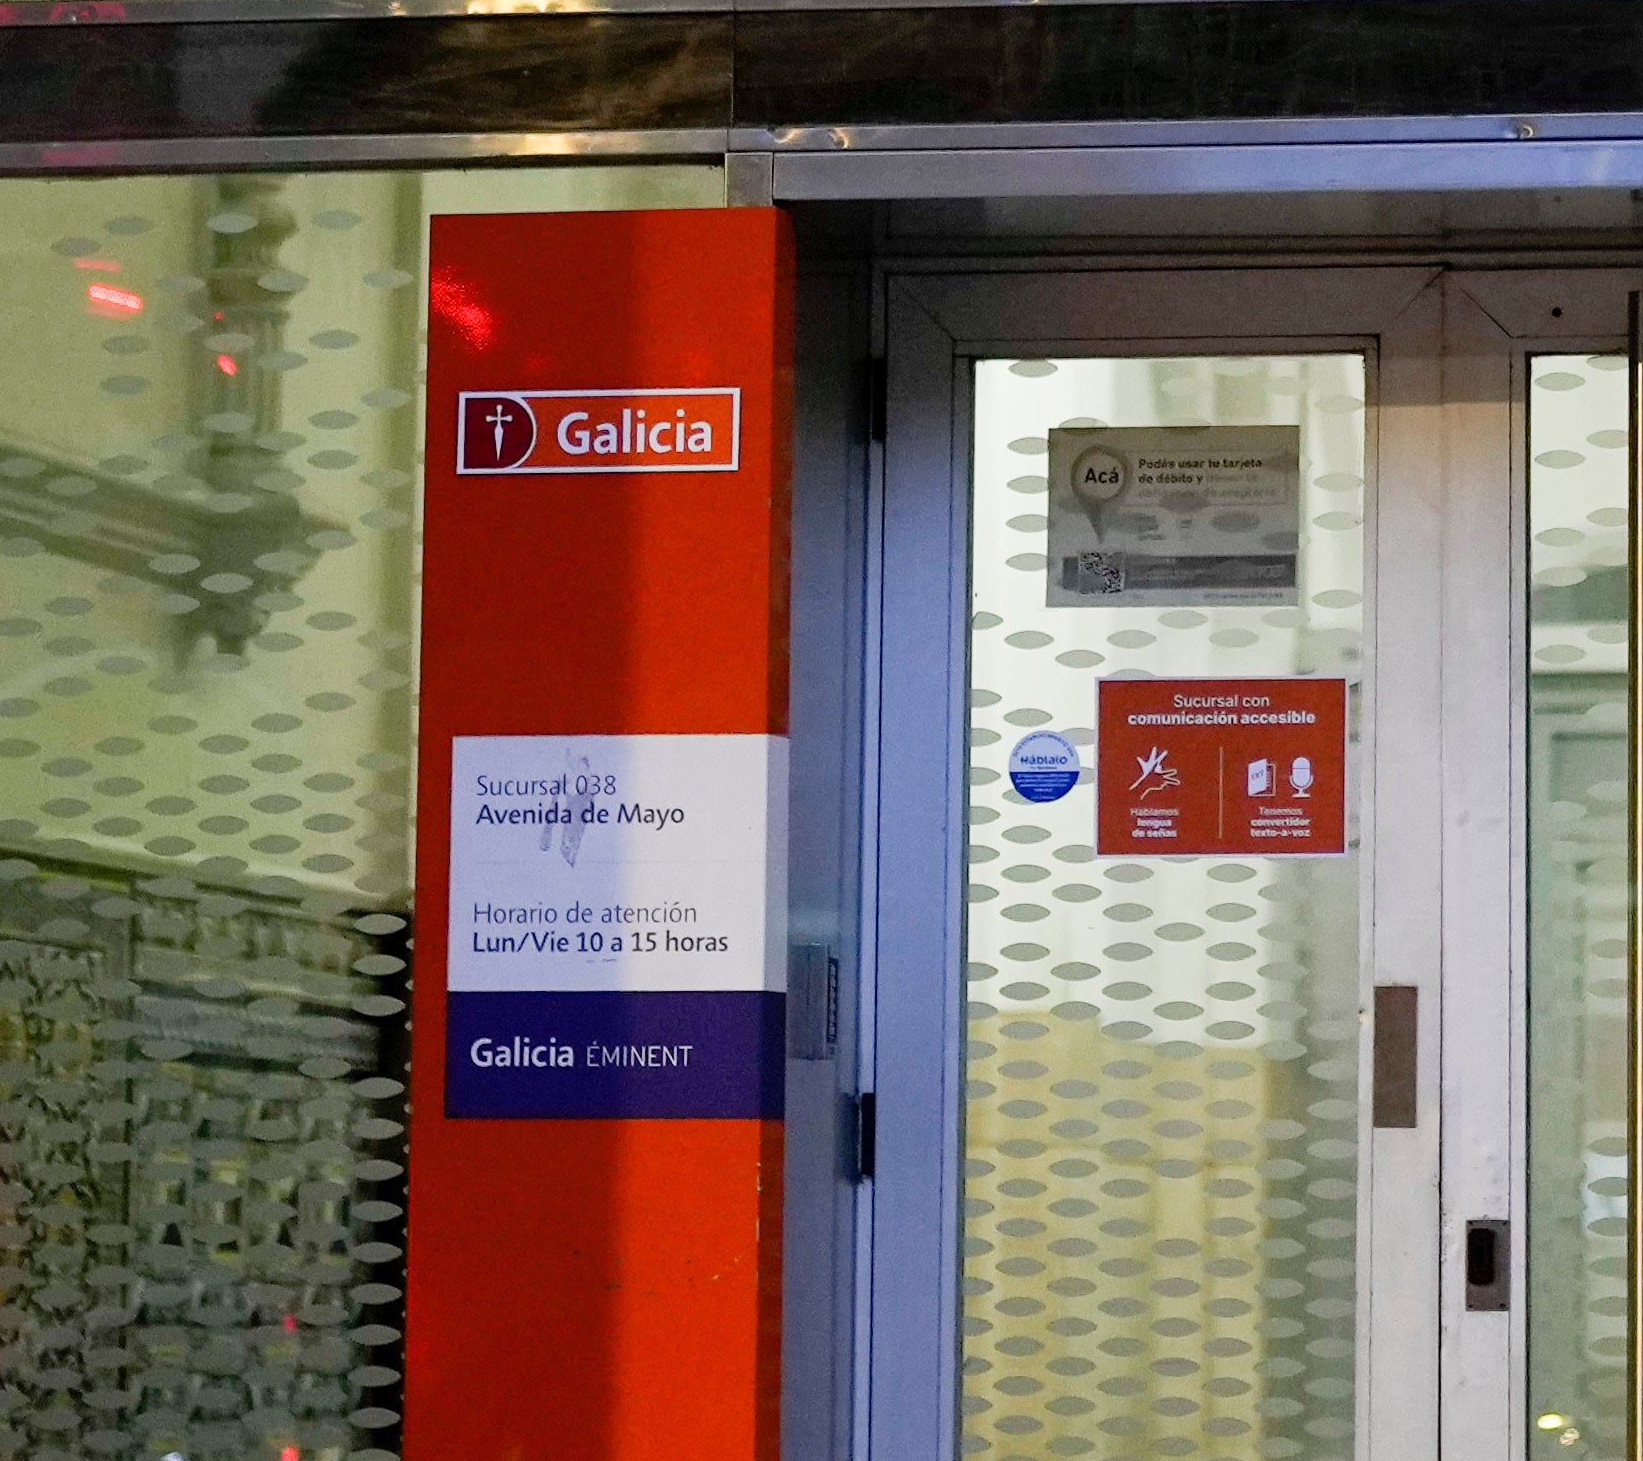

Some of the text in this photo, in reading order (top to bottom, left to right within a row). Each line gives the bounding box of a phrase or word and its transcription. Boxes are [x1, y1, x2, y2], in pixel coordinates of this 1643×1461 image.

[557, 408, 713, 455] Galicia
[1138, 458, 1263, 471] Podés usar tu tarjeta
[1084, 467, 1119, 484] Acá
[1138, 474, 1154, 484] de
[1156, 474, 1193, 484] débito
[1196, 476, 1204, 485] y
[1174, 694, 1270, 708] Sucursal con
[1128, 711, 1316, 725] comunicación accesible
[476, 774, 617, 796] Sucursal 038
[476, 803, 685, 831] Avenida de Mayo
[1130, 807, 1179, 817] Hablamos
[1258, 806, 1303, 816] Tenemos
[1137, 817, 1172, 828] lengua
[1250, 817, 1311, 827] convertidor
[1131, 827, 1178, 838] de señas
[473, 901, 698, 925] Horario de atención
[473, 931, 729, 953] Lun/Vie 10 a 15 horas
[470, 1036, 694, 1068] Galicia ÉMINENT
